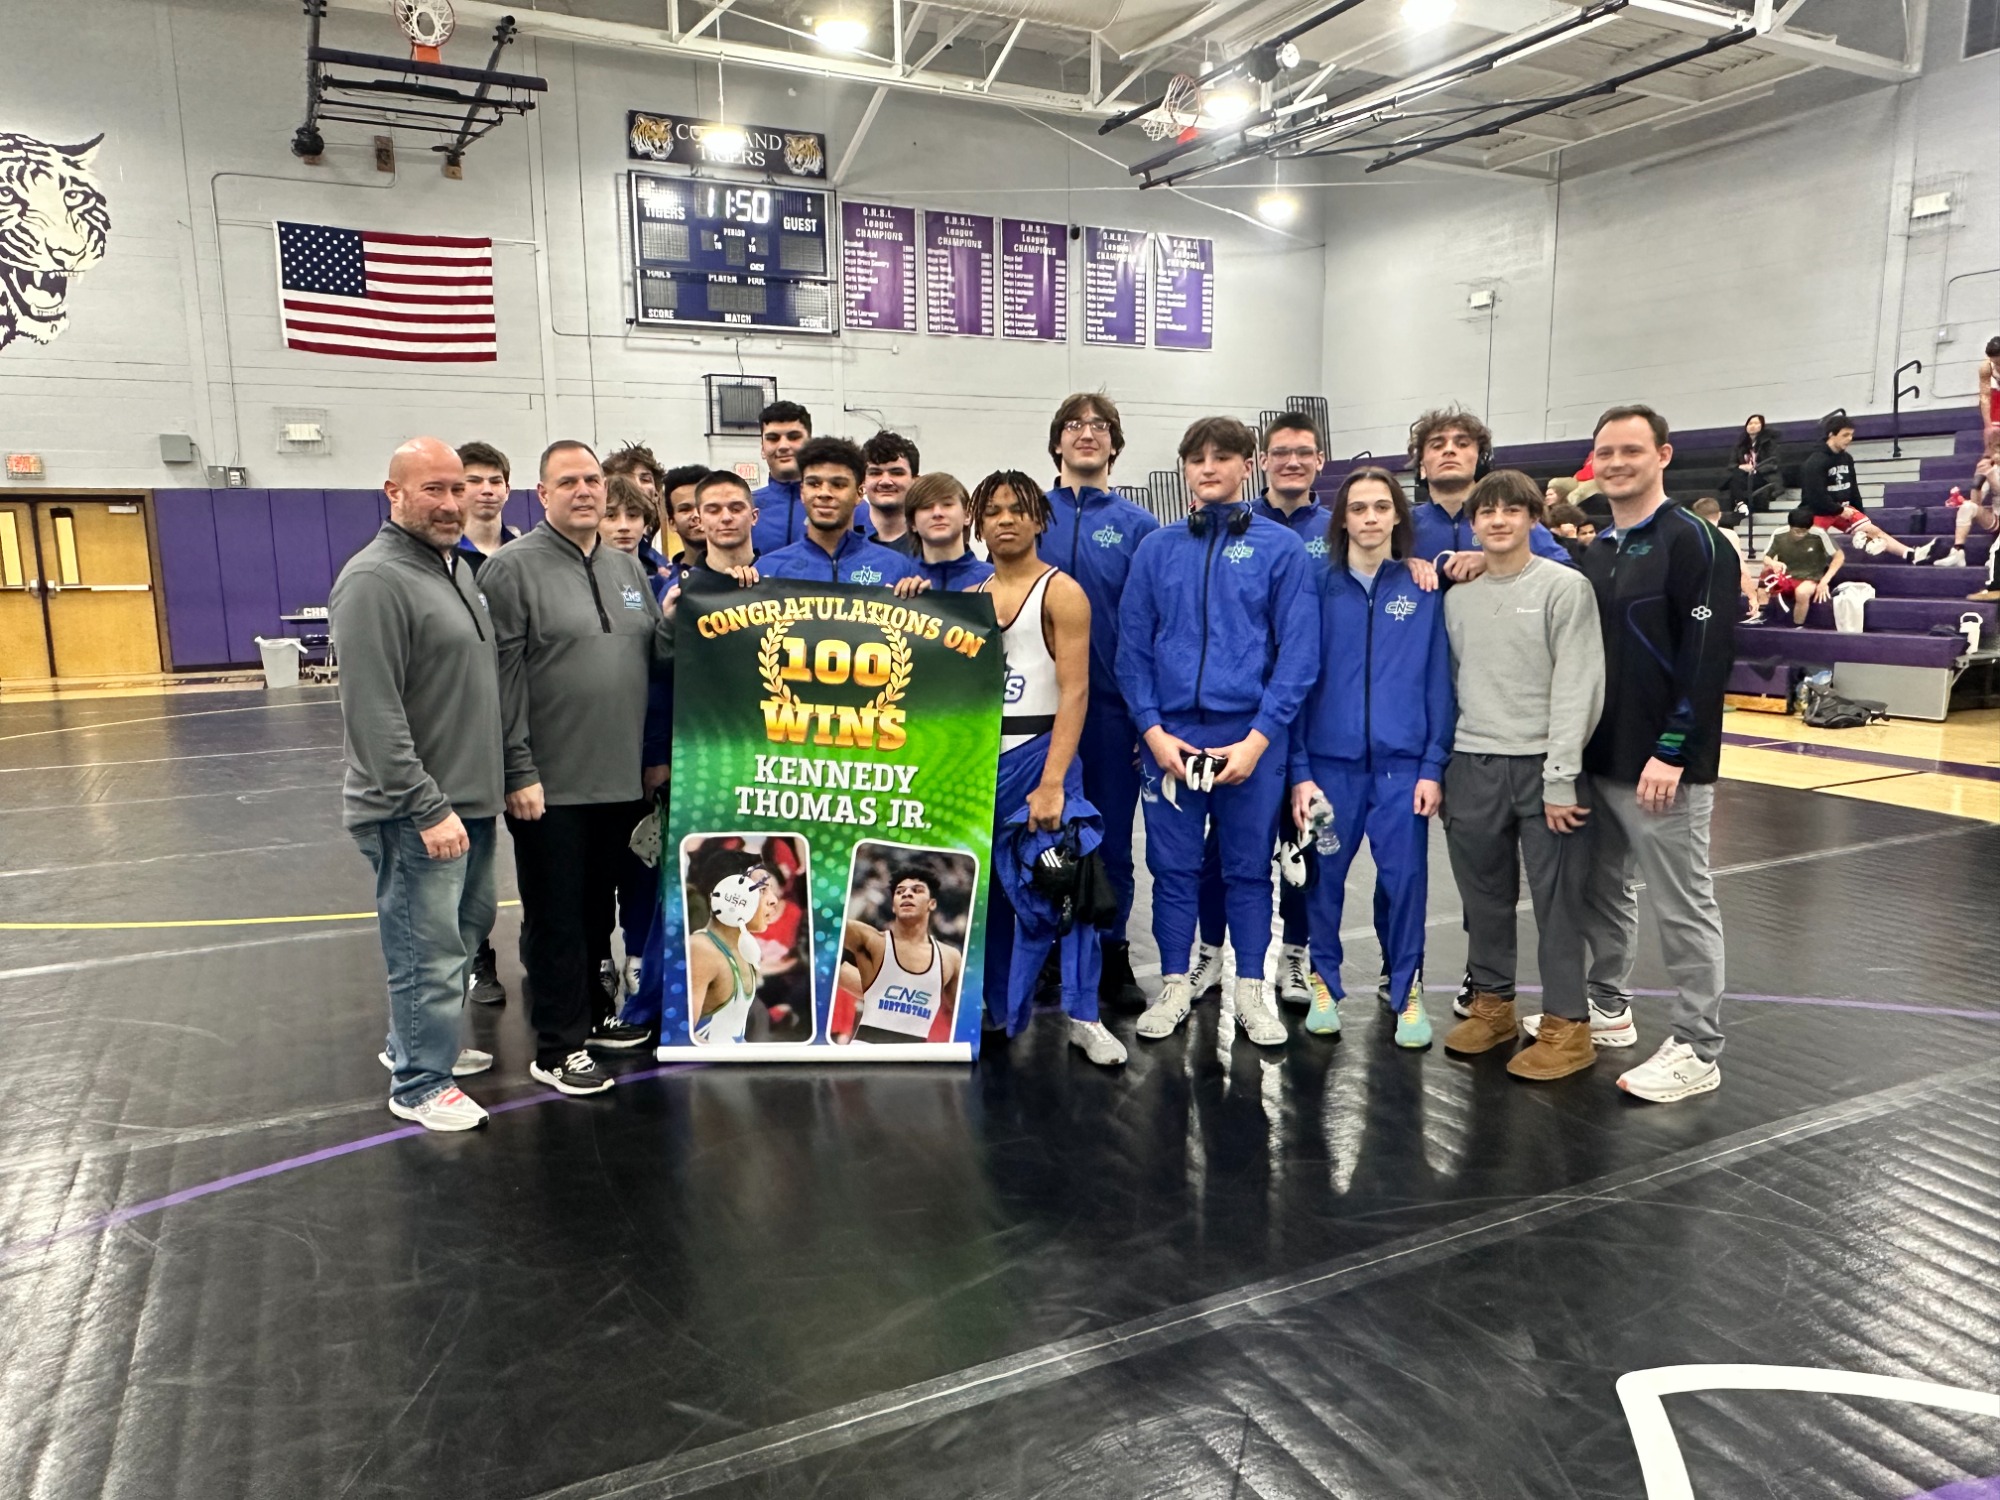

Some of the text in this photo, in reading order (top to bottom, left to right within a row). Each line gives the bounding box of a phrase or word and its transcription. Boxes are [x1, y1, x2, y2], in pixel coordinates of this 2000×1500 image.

[707, 187, 770, 223] 11:50
[783, 216, 817, 232] GUEST
[865, 219, 893, 230] League
[855, 228, 903, 241] CHAMPIONS
[946, 227, 973, 237] League
[1022, 234, 1048, 244] League
[937, 237, 982, 248] CHAMPIONS
[1014, 244, 1056, 255] CHAMPIONS
[648, 309, 674, 319] SCORE
[725, 313, 751, 324] MATCH
[697, 596, 986, 659] CONGRATULATIONS ON
[780, 636, 892, 687] 100
[759, 700, 907, 751] WINS
[754, 754, 919, 794] KENNEDY
[735, 786, 932, 829] THOMAS JR.
[884, 985, 932, 1005] CNS
